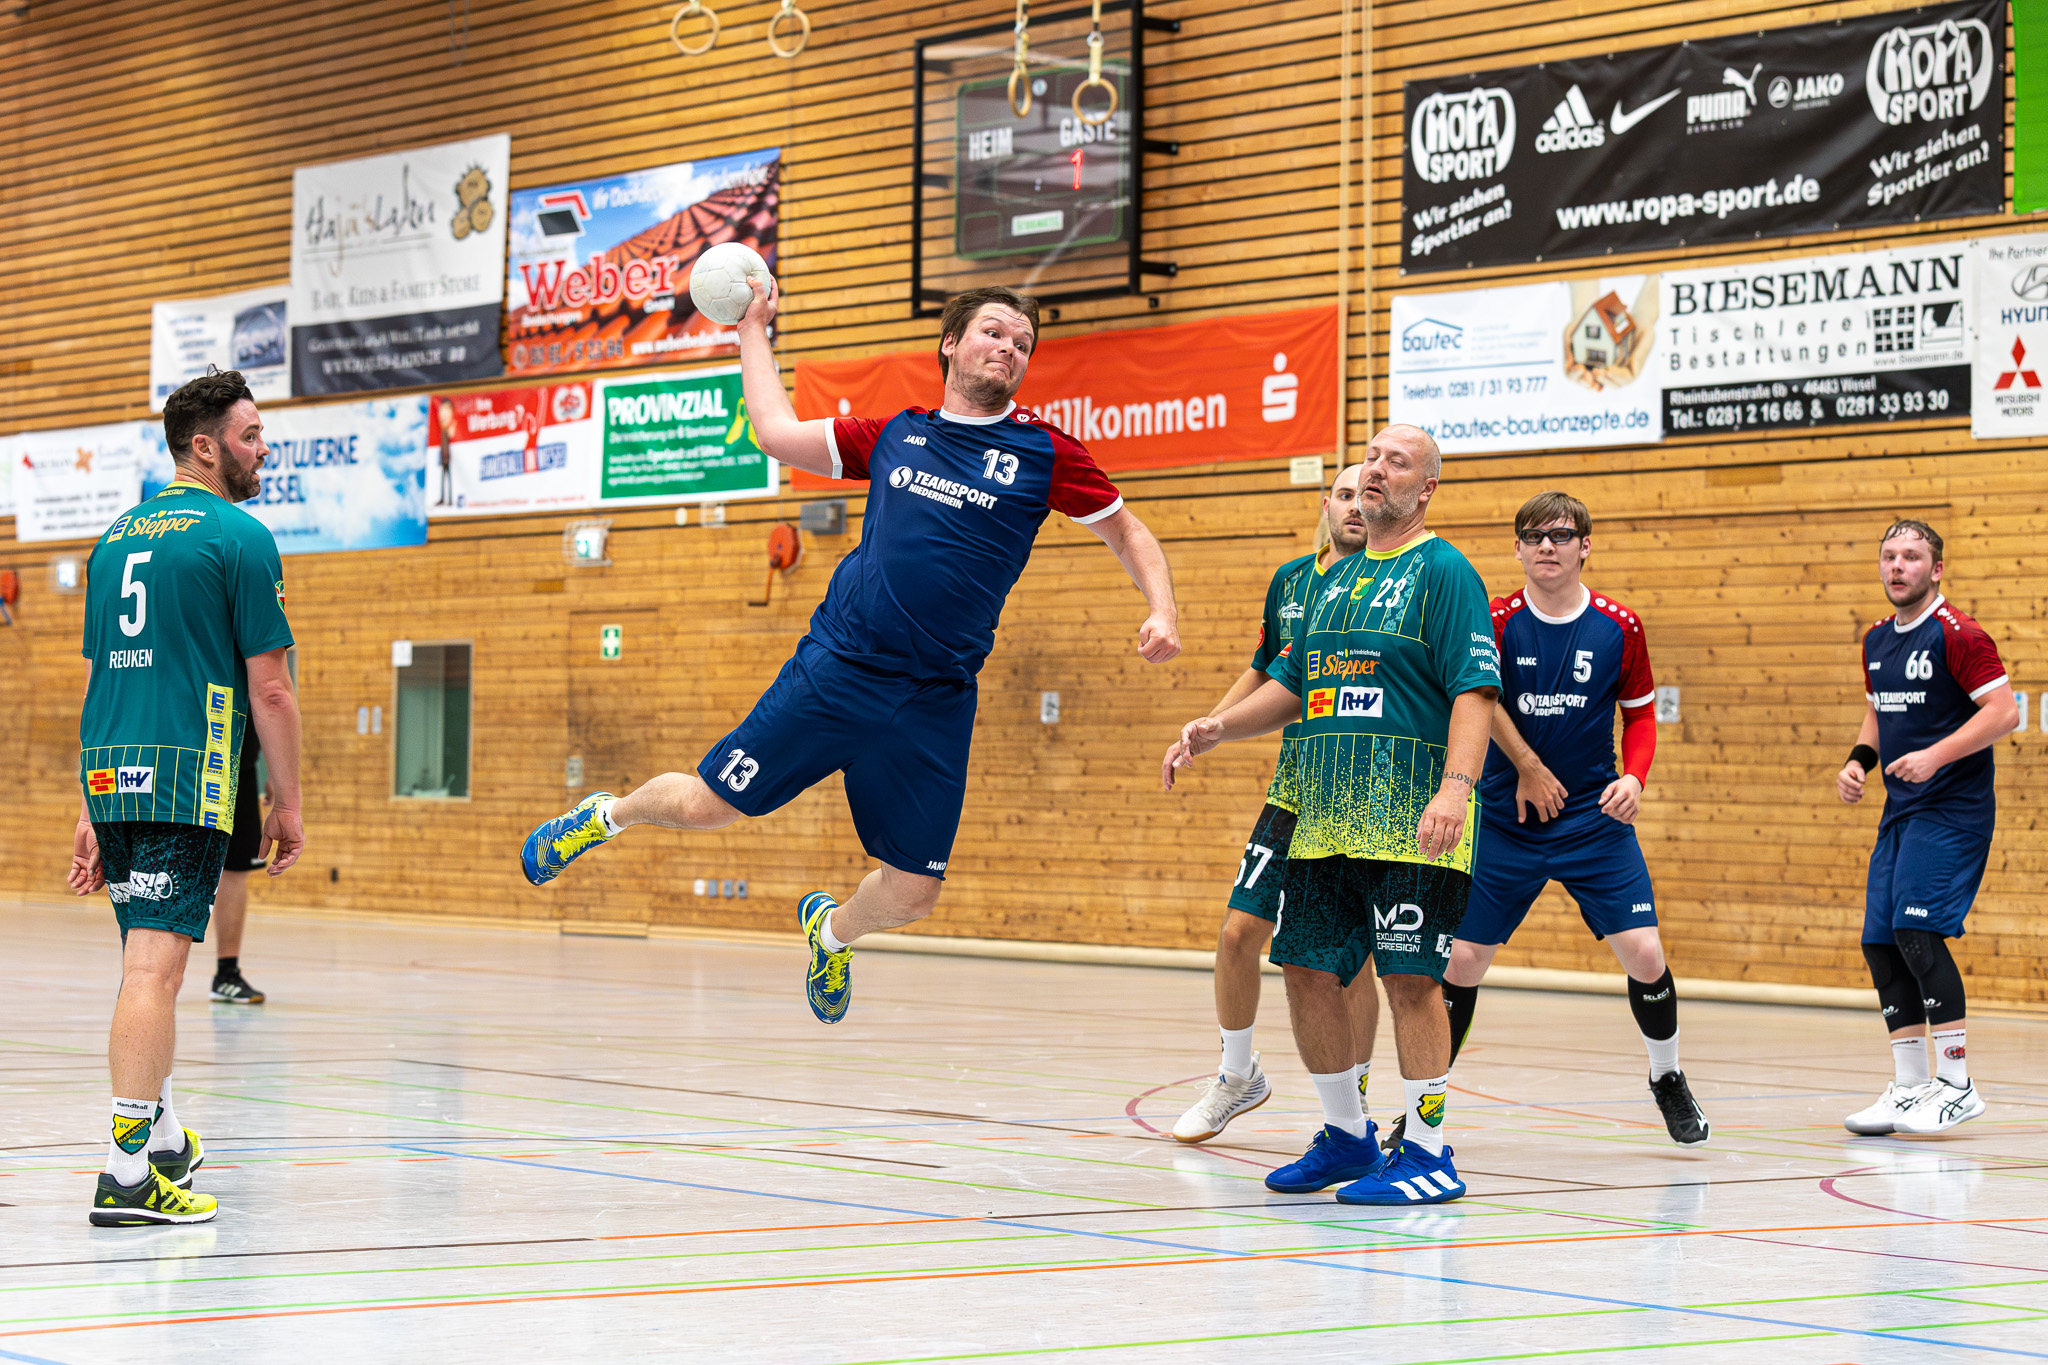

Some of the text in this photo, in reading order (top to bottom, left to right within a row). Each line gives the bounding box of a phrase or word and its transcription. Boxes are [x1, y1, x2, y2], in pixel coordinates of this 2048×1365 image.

[1793, 73, 1844, 101] JAKO
[1687, 89, 1746, 124] PUMA
[1887, 85, 1970, 125] SPORT
[968, 127, 1013, 161] HEIM
[1535, 124, 1606, 154] adidas
[1869, 124, 1981, 178] Wir ziehen
[1070, 148, 1084, 191] 1
[1429, 146, 1497, 184] SPORT
[1867, 141, 1990, 206] Sportler an!
[1413, 184, 1505, 231] Wir ziehen
[1556, 172, 1821, 230] www.ropa-sport.de
[1411, 200, 1513, 256] Sportler an!
[517, 253, 678, 311] Weber
[1670, 255, 1964, 316] BIESEMANN
[1670, 309, 1871, 346] Tischlerei
[2001, 306, 2048, 324] HYUN
[1402, 331, 1463, 353] bautec
[1671, 341, 1867, 371] Bestattungen
[1448, 380, 1475, 398] 0281
[1489, 379, 1503, 396] 31
[1506, 377, 1522, 394] 93
[1525, 376, 1548, 393] 777
[1840, 375, 1876, 393] Wesel
[1995, 392, 2041, 405] MITSUBISHI
[607, 387, 728, 427] PROVINZIAL
[1670, 388, 1950, 430] Tel.: 0281 2 16 66 & 0281 33 93 30
[2001, 405, 2034, 417] MOTORS
[1421, 407, 1650, 440] w.bautec-baukonzepte.de
[264, 434, 359, 470] DTWERKE
[903, 434, 927, 447] JAKO
[981, 448, 1020, 486] 13
[908, 483, 964, 509] NIEDERRHEIN
[913, 470, 998, 510] TEAMSPORT
[127, 517, 201, 540] Stepper
[118, 550, 154, 637] 5
[1370, 578, 1407, 608] 23
[109, 649, 153, 668] REUKEN
[1322, 654, 1380, 681] Stepper
[1573, 649, 1593, 683] 5
[1904, 650, 1933, 680] 66
[1341, 692, 1380, 711] R+V
[1879, 691, 1927, 704] TEAMSPORT
[120, 771, 151, 788] R+V
[717, 748, 760, 792] 13
[926, 860, 946, 872] JAKO
[1631, 902, 1652, 914] JAKO
[1904, 906, 1928, 918] JAKO
[1643, 987, 1670, 1001] SELECT
[117, 1101, 148, 1110] Handball
